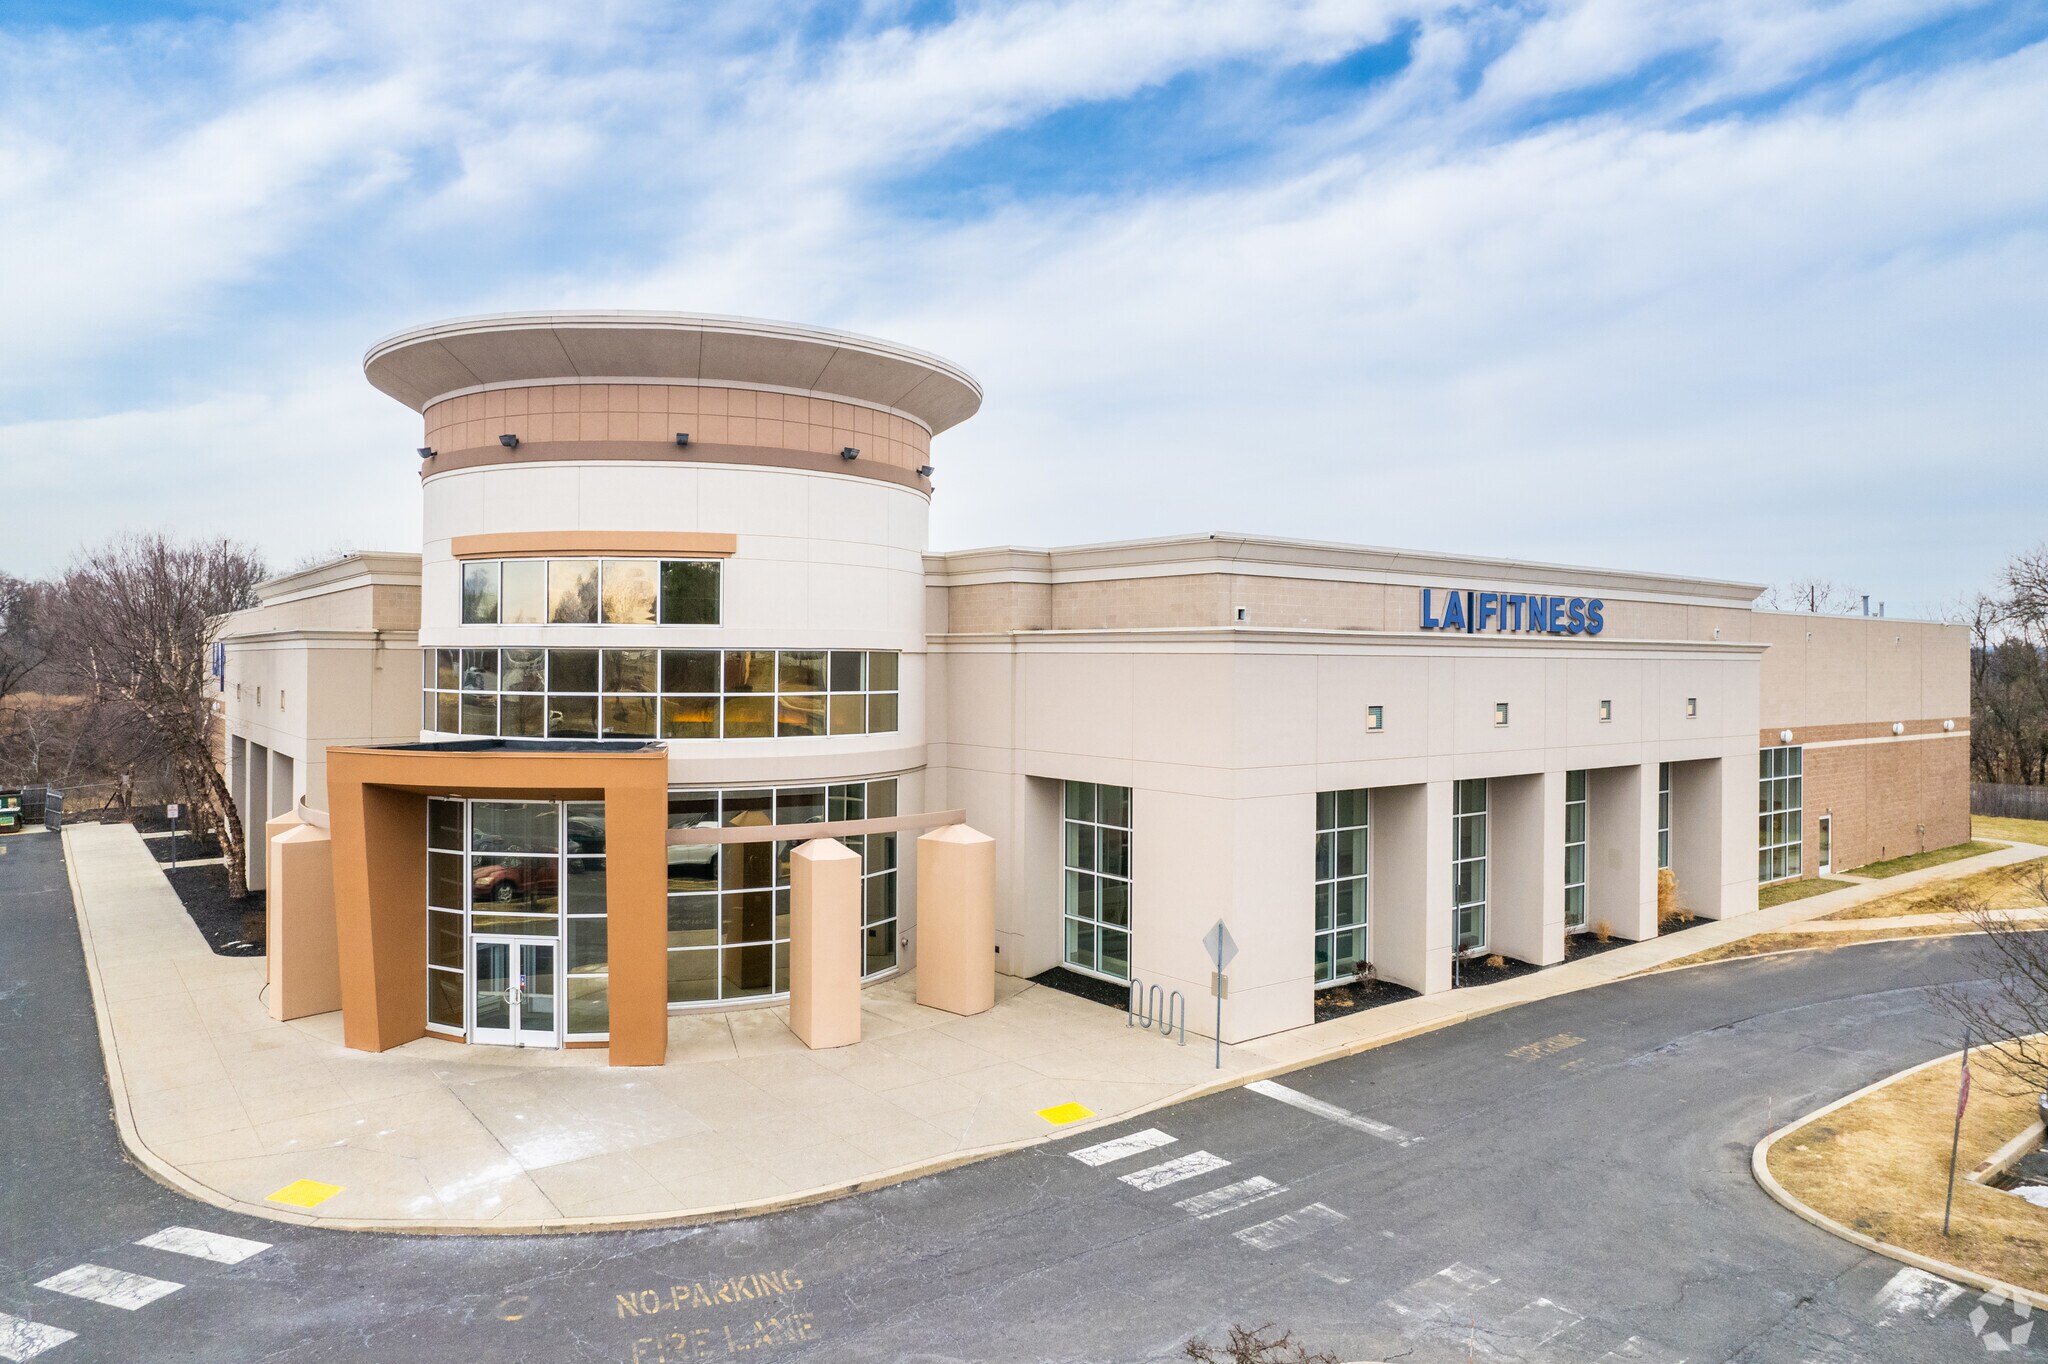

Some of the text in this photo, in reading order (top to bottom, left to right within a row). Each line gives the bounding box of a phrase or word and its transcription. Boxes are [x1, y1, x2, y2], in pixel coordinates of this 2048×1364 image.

[1477, 592, 1604, 635] FITNESS
[616, 1269, 804, 1319] NO PARKING
